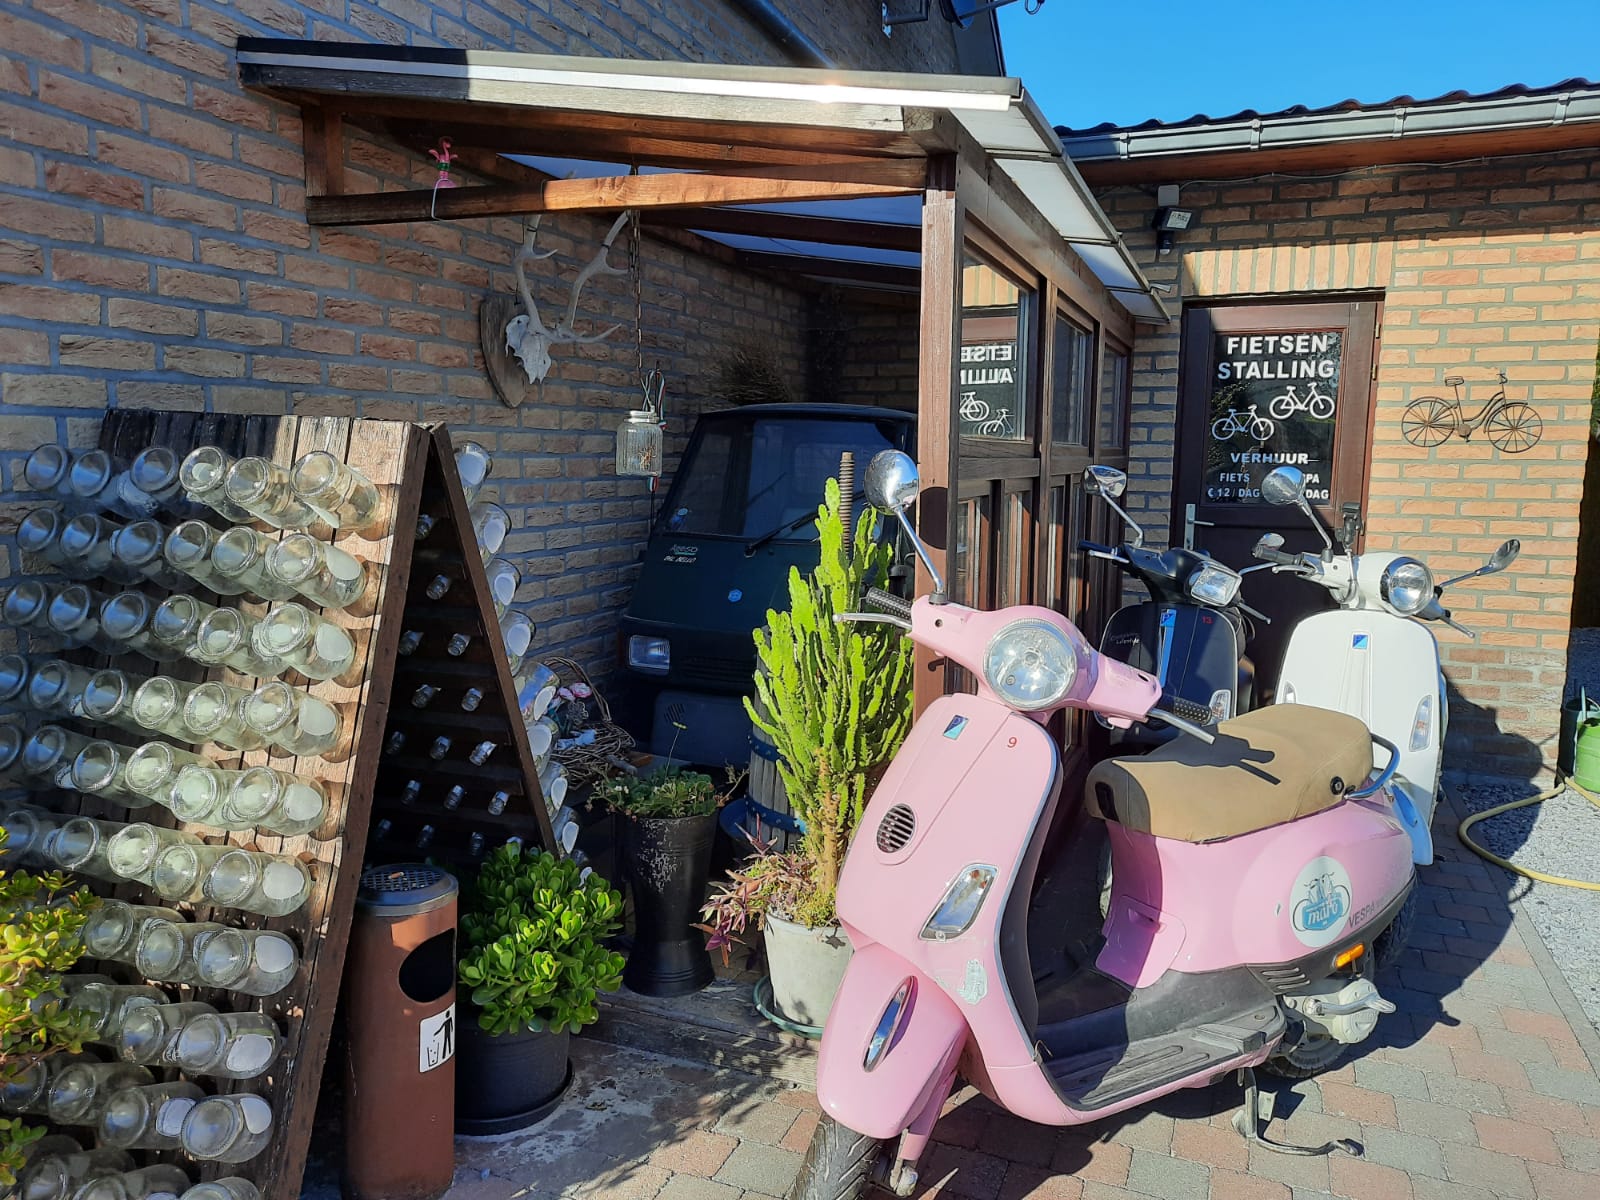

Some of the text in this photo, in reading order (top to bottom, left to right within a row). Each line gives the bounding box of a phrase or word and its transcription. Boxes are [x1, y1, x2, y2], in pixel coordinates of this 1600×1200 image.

[1227, 335, 1328, 354] FIETSEN
[1217, 360, 1335, 380] STALLING
[1230, 452, 1309, 464] VERHUUR
[1219, 472, 1250, 483] FIETS
[1238, 488, 1260, 498] DAG
[1305, 489, 1329, 499] DAG
[1202, 615, 1214, 624] 13
[1007, 736, 1018, 748] 9
[1348, 900, 1375, 928] VESPA
